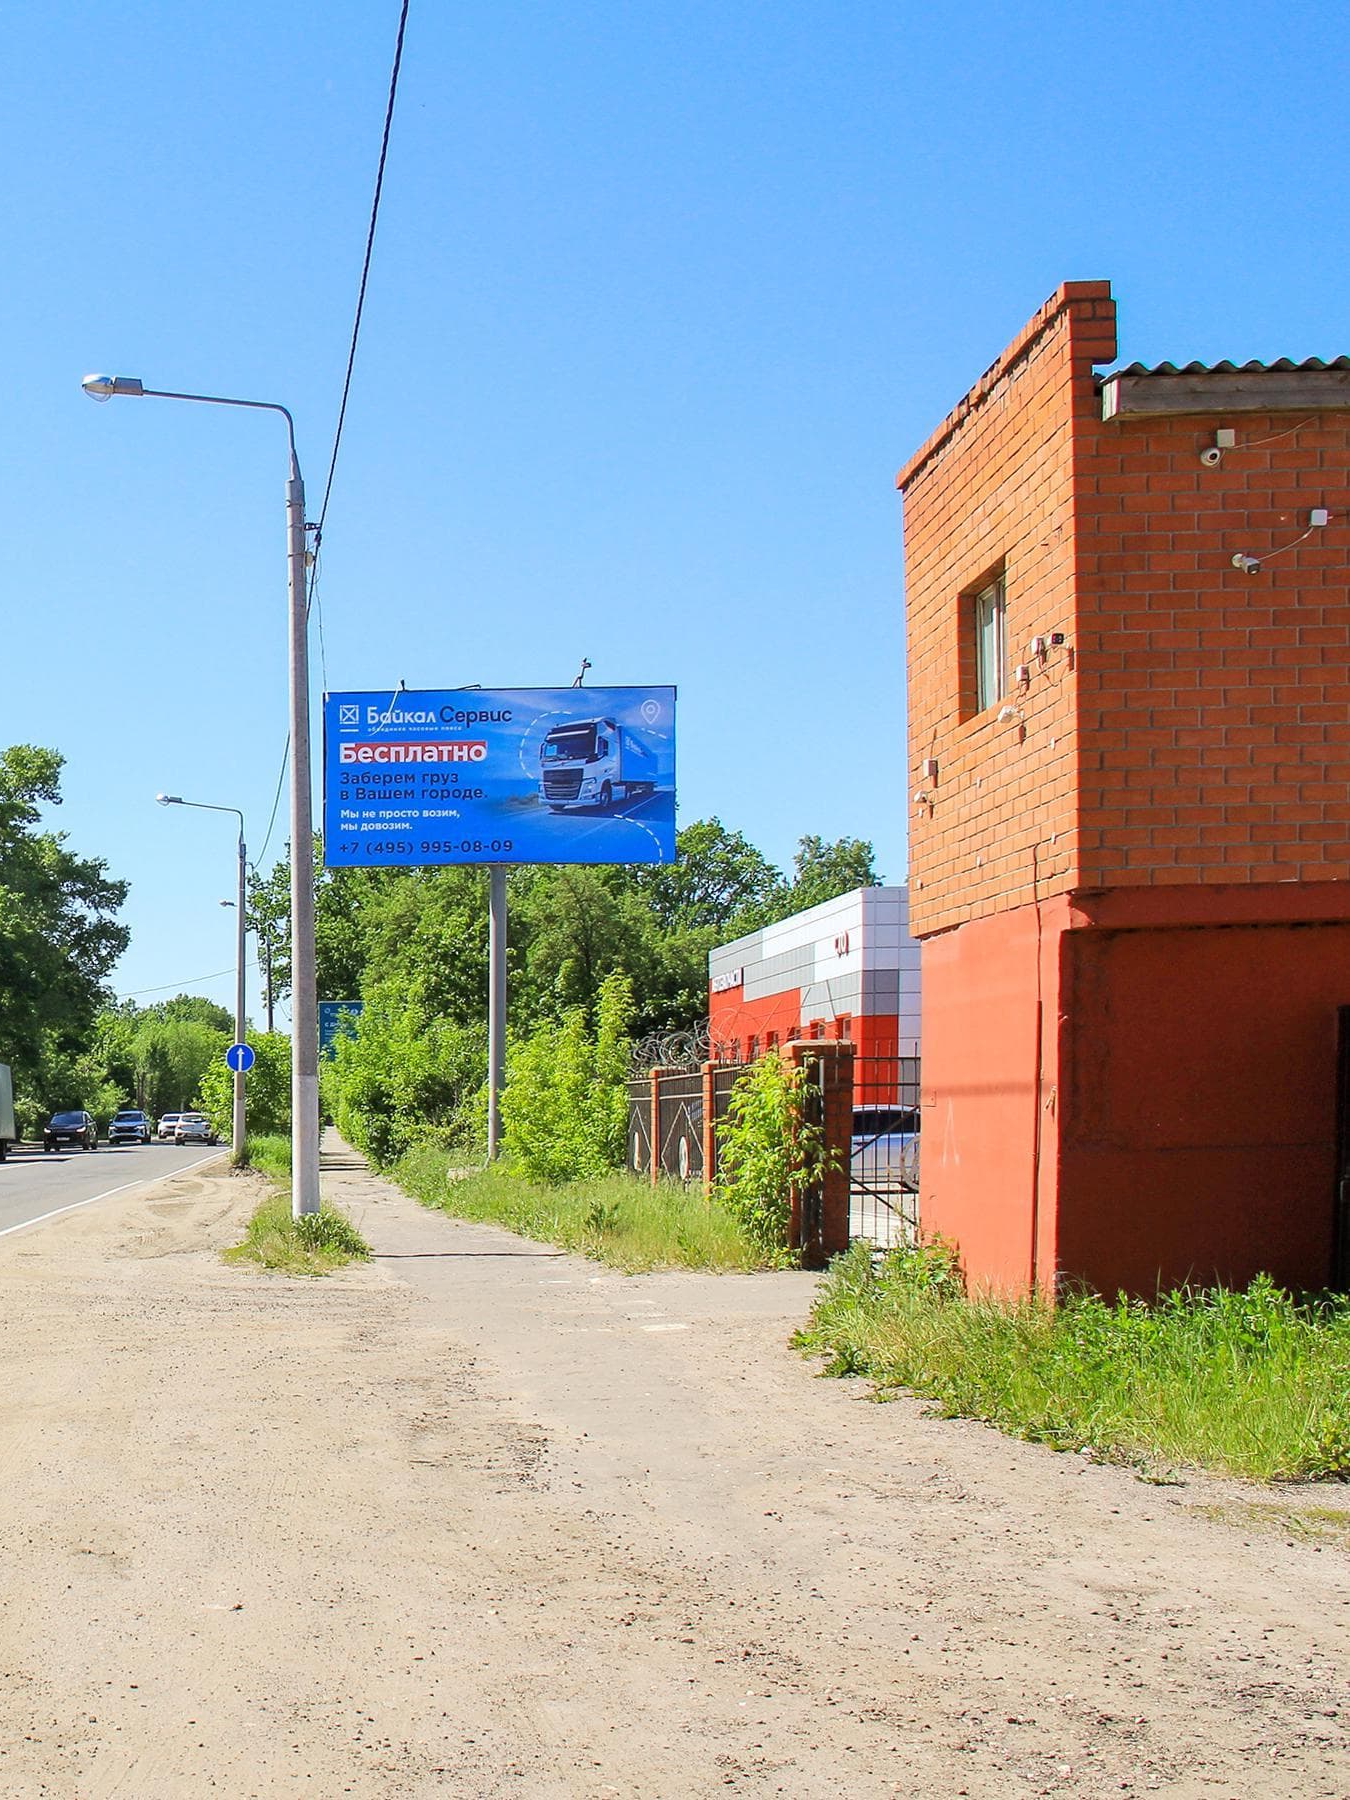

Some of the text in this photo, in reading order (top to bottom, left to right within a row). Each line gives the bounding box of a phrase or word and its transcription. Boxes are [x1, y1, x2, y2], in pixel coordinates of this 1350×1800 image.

[367, 706, 512, 728] Байкал Сервис
[339, 742, 488, 764] Бесплатно
[340, 772, 459, 786] Заберем груз
[340, 788, 488, 801] в Вашем городе.
[340, 809, 461, 819] Мы не просто возим,
[340, 822, 413, 831] мы довозим.
[340, 840, 513, 855] +7 (495) 995-08-09
